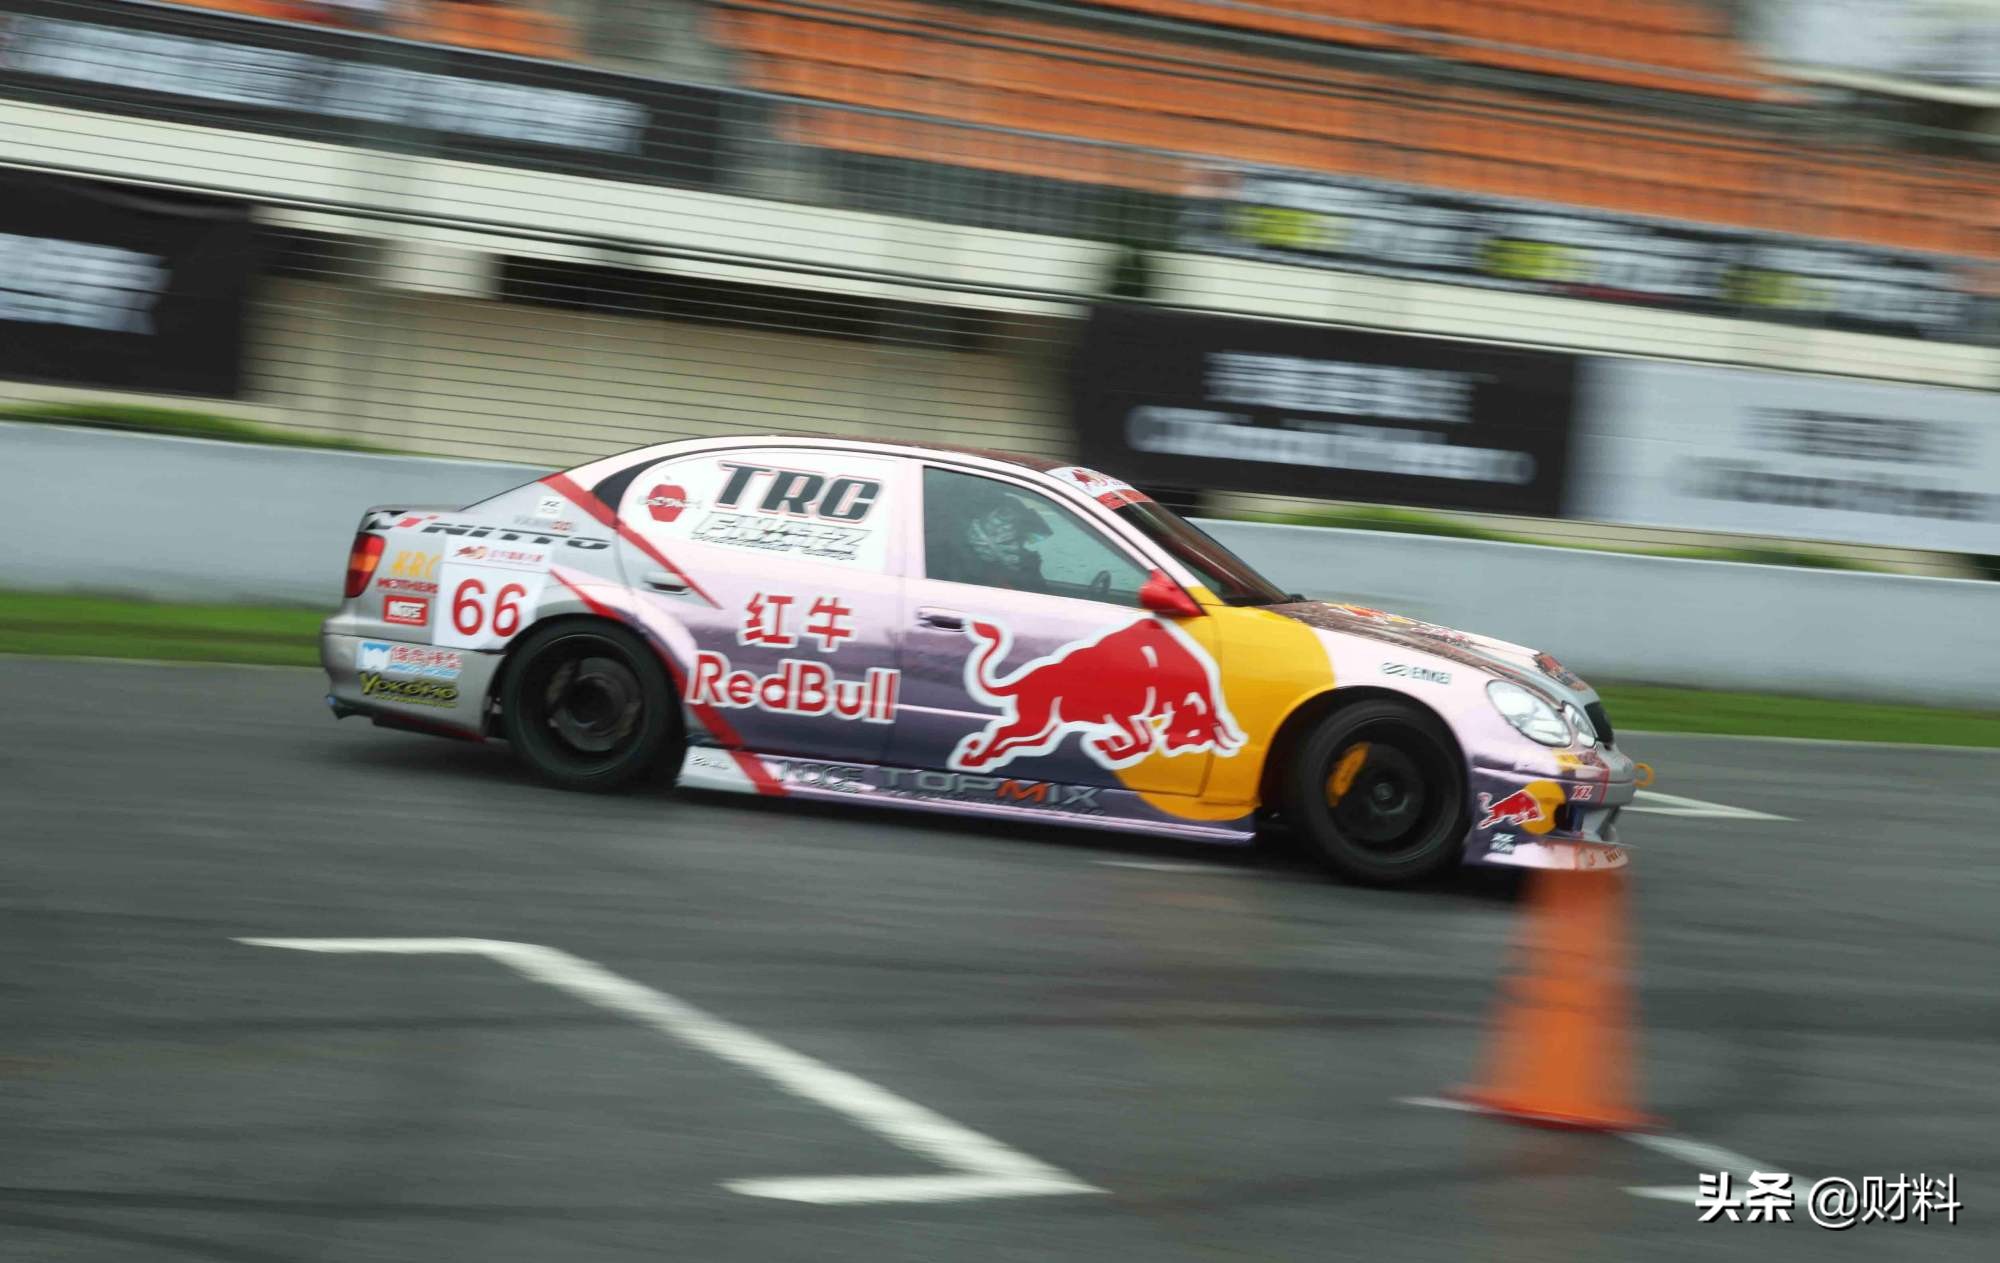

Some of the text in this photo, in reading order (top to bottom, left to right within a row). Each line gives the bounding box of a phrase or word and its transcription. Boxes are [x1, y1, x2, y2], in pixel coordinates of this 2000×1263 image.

[717, 461, 881, 524] TRC
[420, 522, 611, 550] NITTO
[453, 578, 527, 637] 66
[743, 591, 853, 650] 红牛
[879, 766, 1101, 808] TOPMIX
